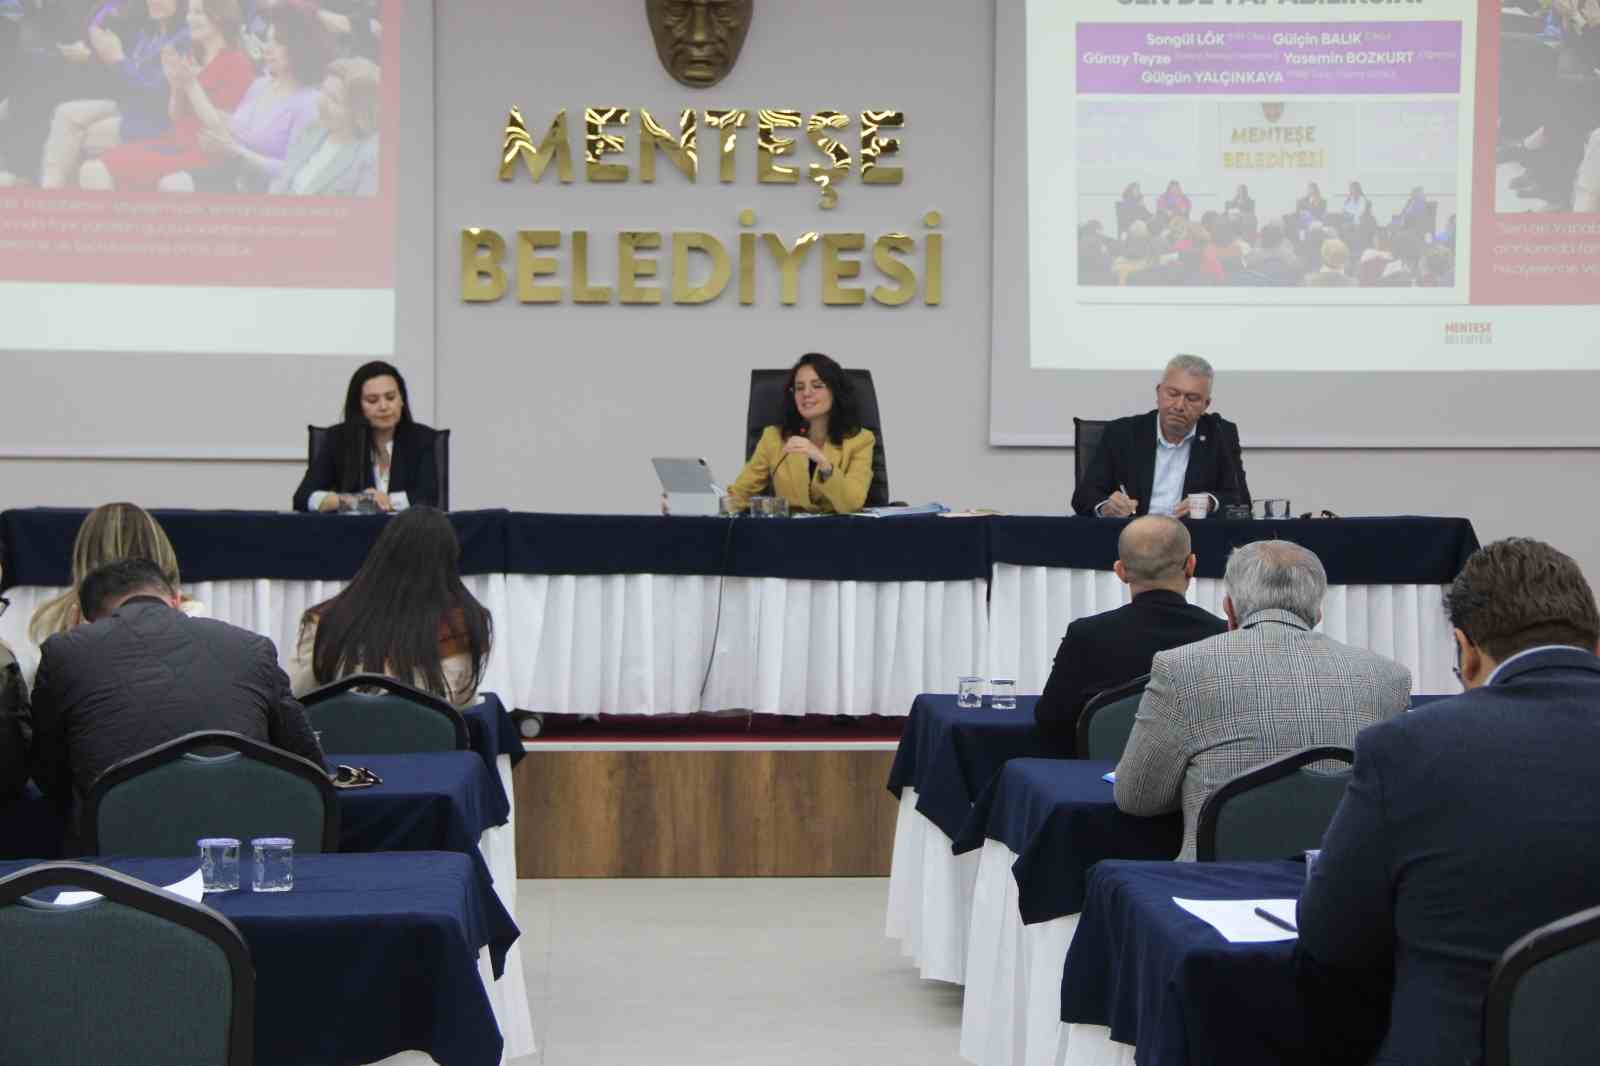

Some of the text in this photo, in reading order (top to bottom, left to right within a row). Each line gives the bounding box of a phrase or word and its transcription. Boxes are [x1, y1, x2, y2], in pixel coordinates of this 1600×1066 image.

[1146, 33, 1194, 48] Songül
[1321, 32, 1362, 45] BALIK
[1083, 52, 1129, 67] Günay
[1133, 52, 1171, 67] Teyze
[1283, 52, 1344, 64] Yasemin
[1346, 51, 1415, 64] BOZKURT
[498, 104, 905, 209] MENTEŞE
[460, 209, 945, 306] BELEDİYESİ
